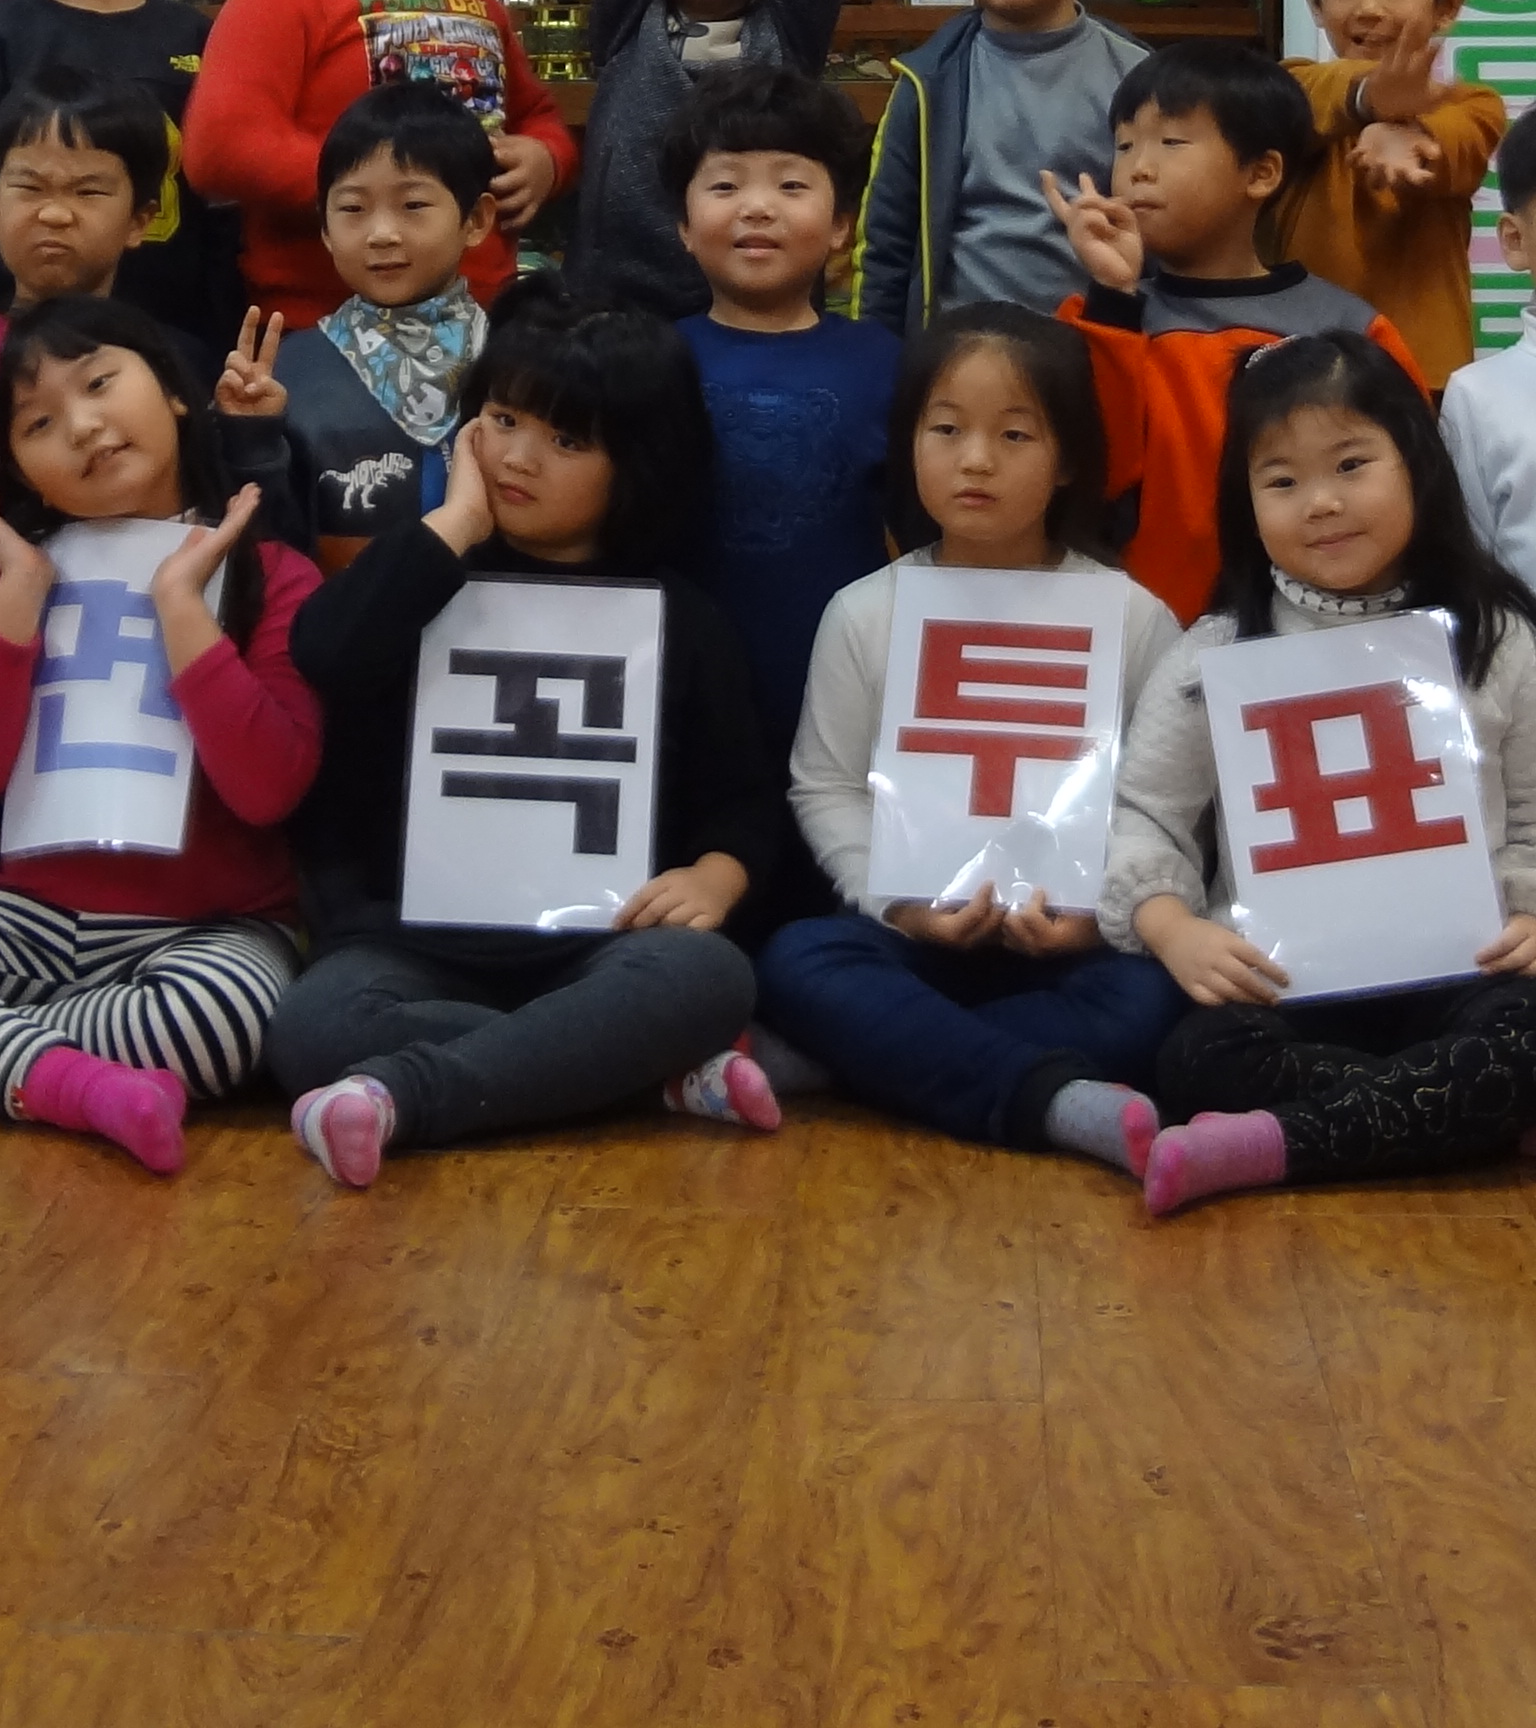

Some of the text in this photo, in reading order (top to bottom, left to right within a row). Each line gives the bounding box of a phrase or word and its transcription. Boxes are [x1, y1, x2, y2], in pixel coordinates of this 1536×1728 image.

[431, 648, 637, 855] 꼭
[896, 618, 1096, 818] 투
[1242, 679, 1467, 875] 표
